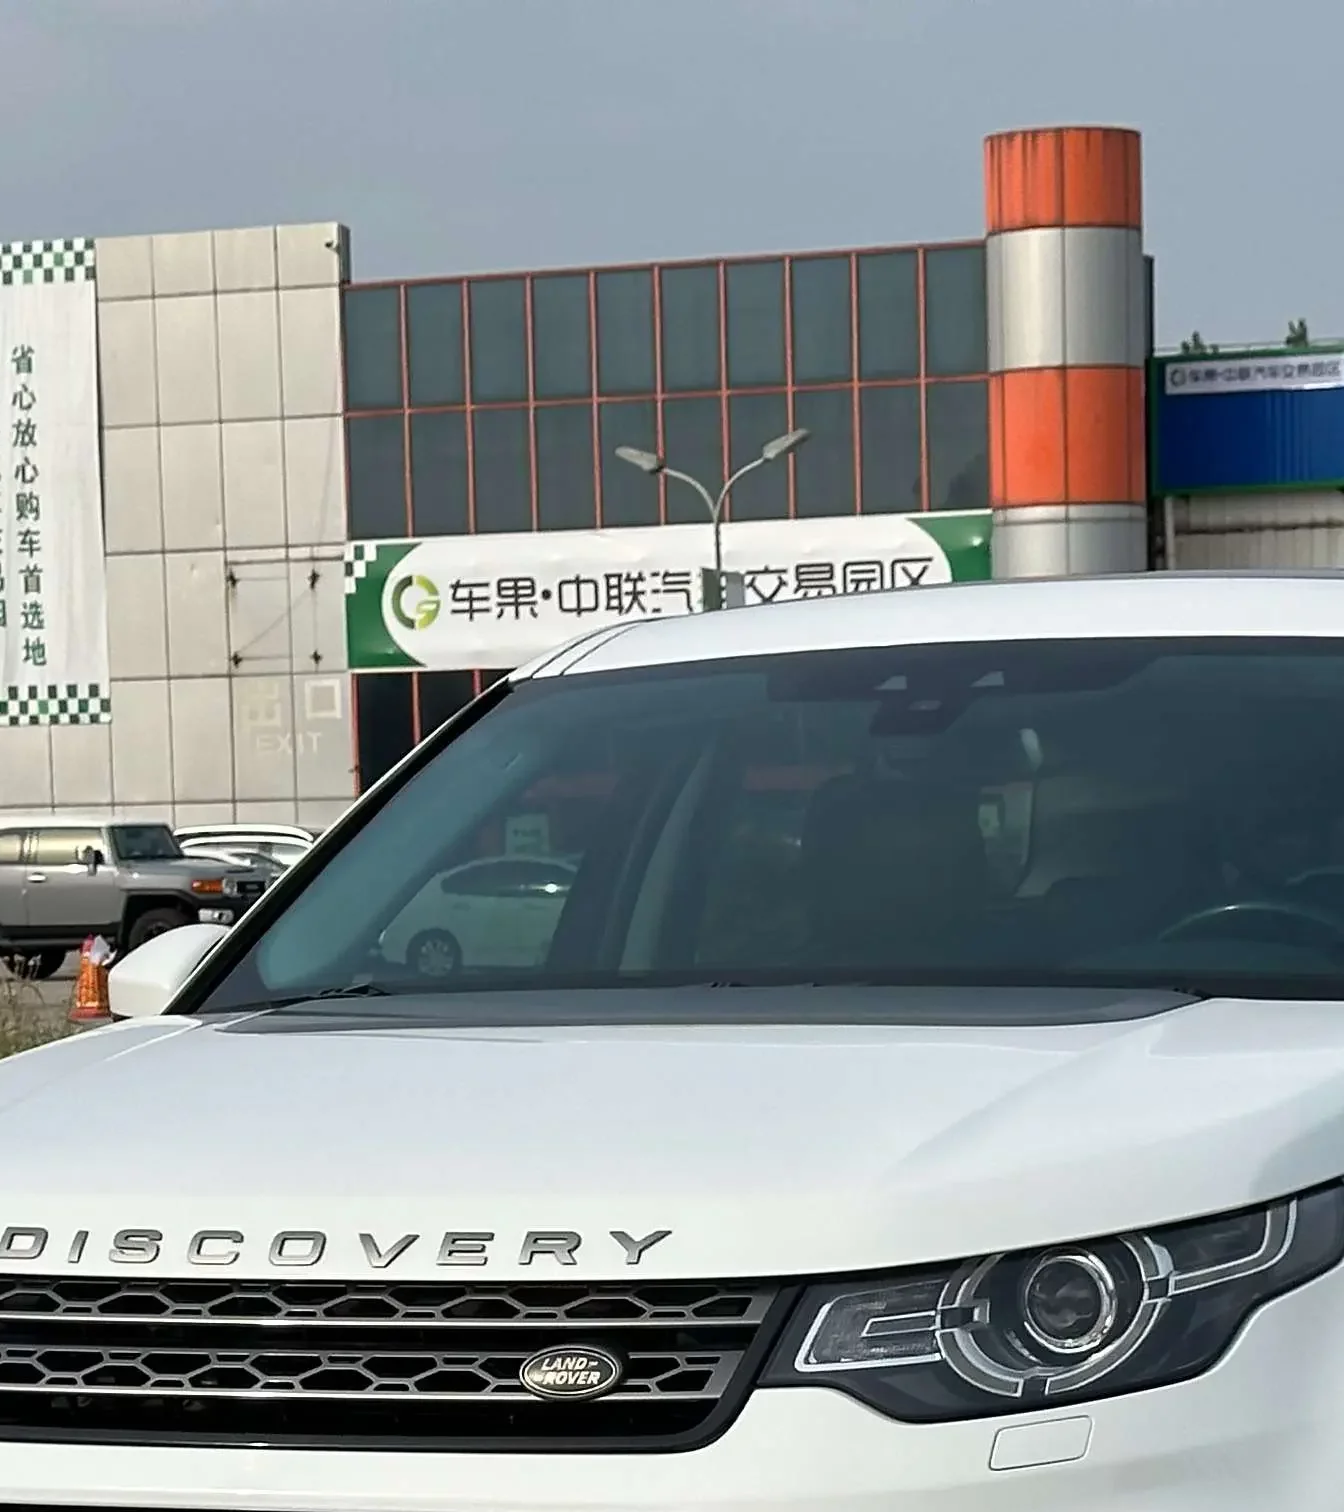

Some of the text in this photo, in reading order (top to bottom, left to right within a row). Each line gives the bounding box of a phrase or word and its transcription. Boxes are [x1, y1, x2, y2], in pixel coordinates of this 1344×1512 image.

[11, 344, 47, 666] 省心放心购车首选地
[449, 557, 934, 621] 车果·中联汽交易园区
[256, 731, 322, 755] EXIT
